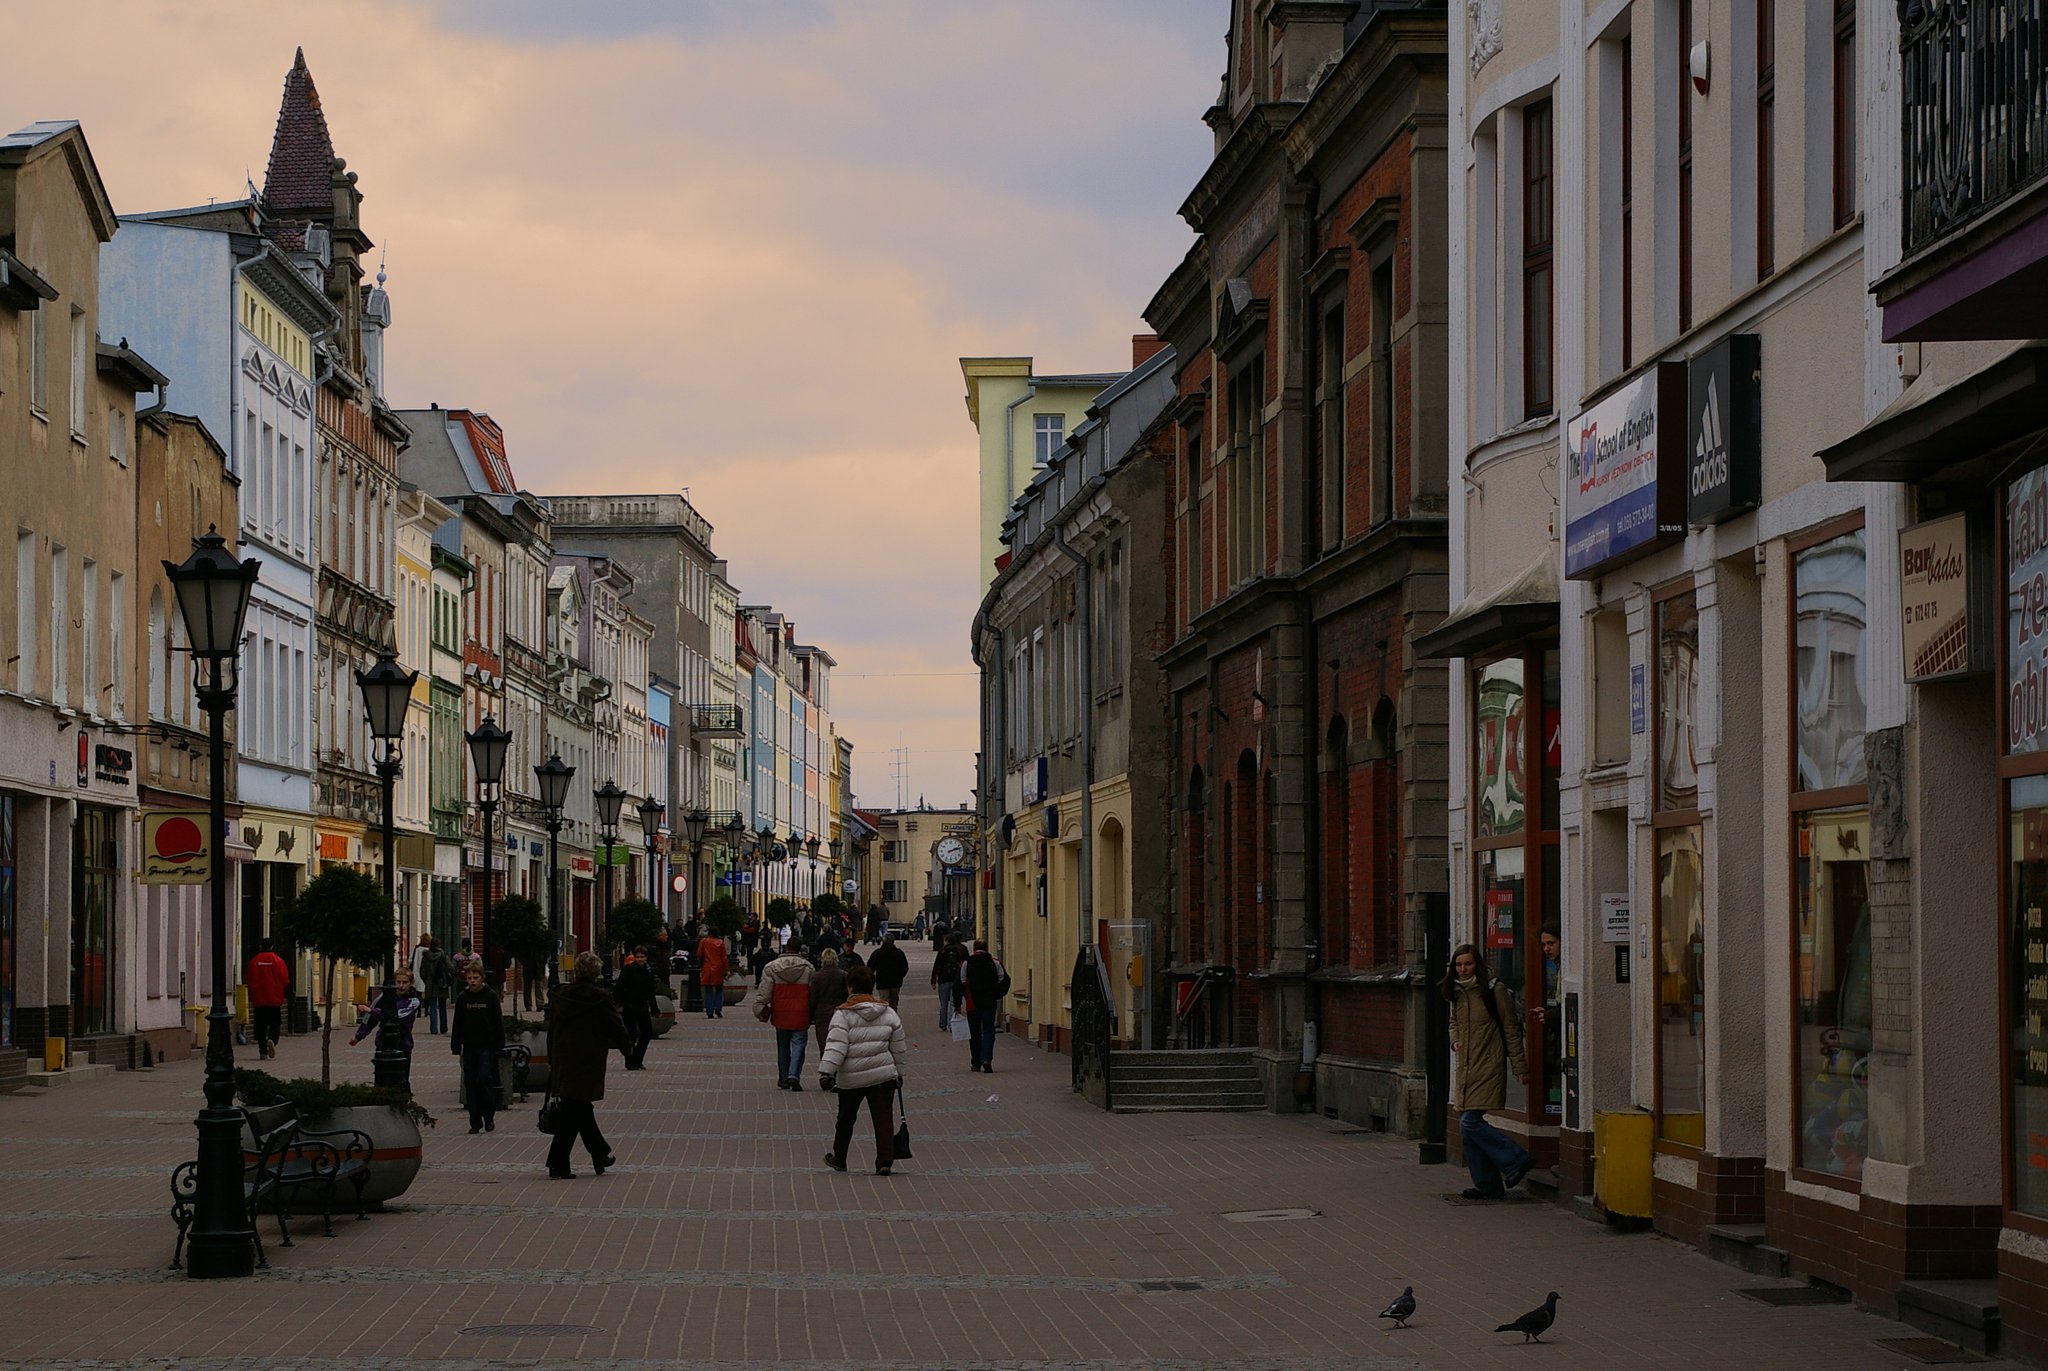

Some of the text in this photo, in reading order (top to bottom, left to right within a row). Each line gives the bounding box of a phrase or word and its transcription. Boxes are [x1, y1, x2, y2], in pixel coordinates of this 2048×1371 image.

[1569, 407, 1654, 481] The School of English
[1691, 448, 1727, 497] adidas
[1915, 600, 1938, 622] 672 47 75
[2018, 570, 2048, 649] ze
[2028, 902, 2042, 931] pizza
[2028, 938, 2044, 964] dania
[2028, 974, 2048, 1000] sałatki
[2028, 1008, 2041, 1039] lody
